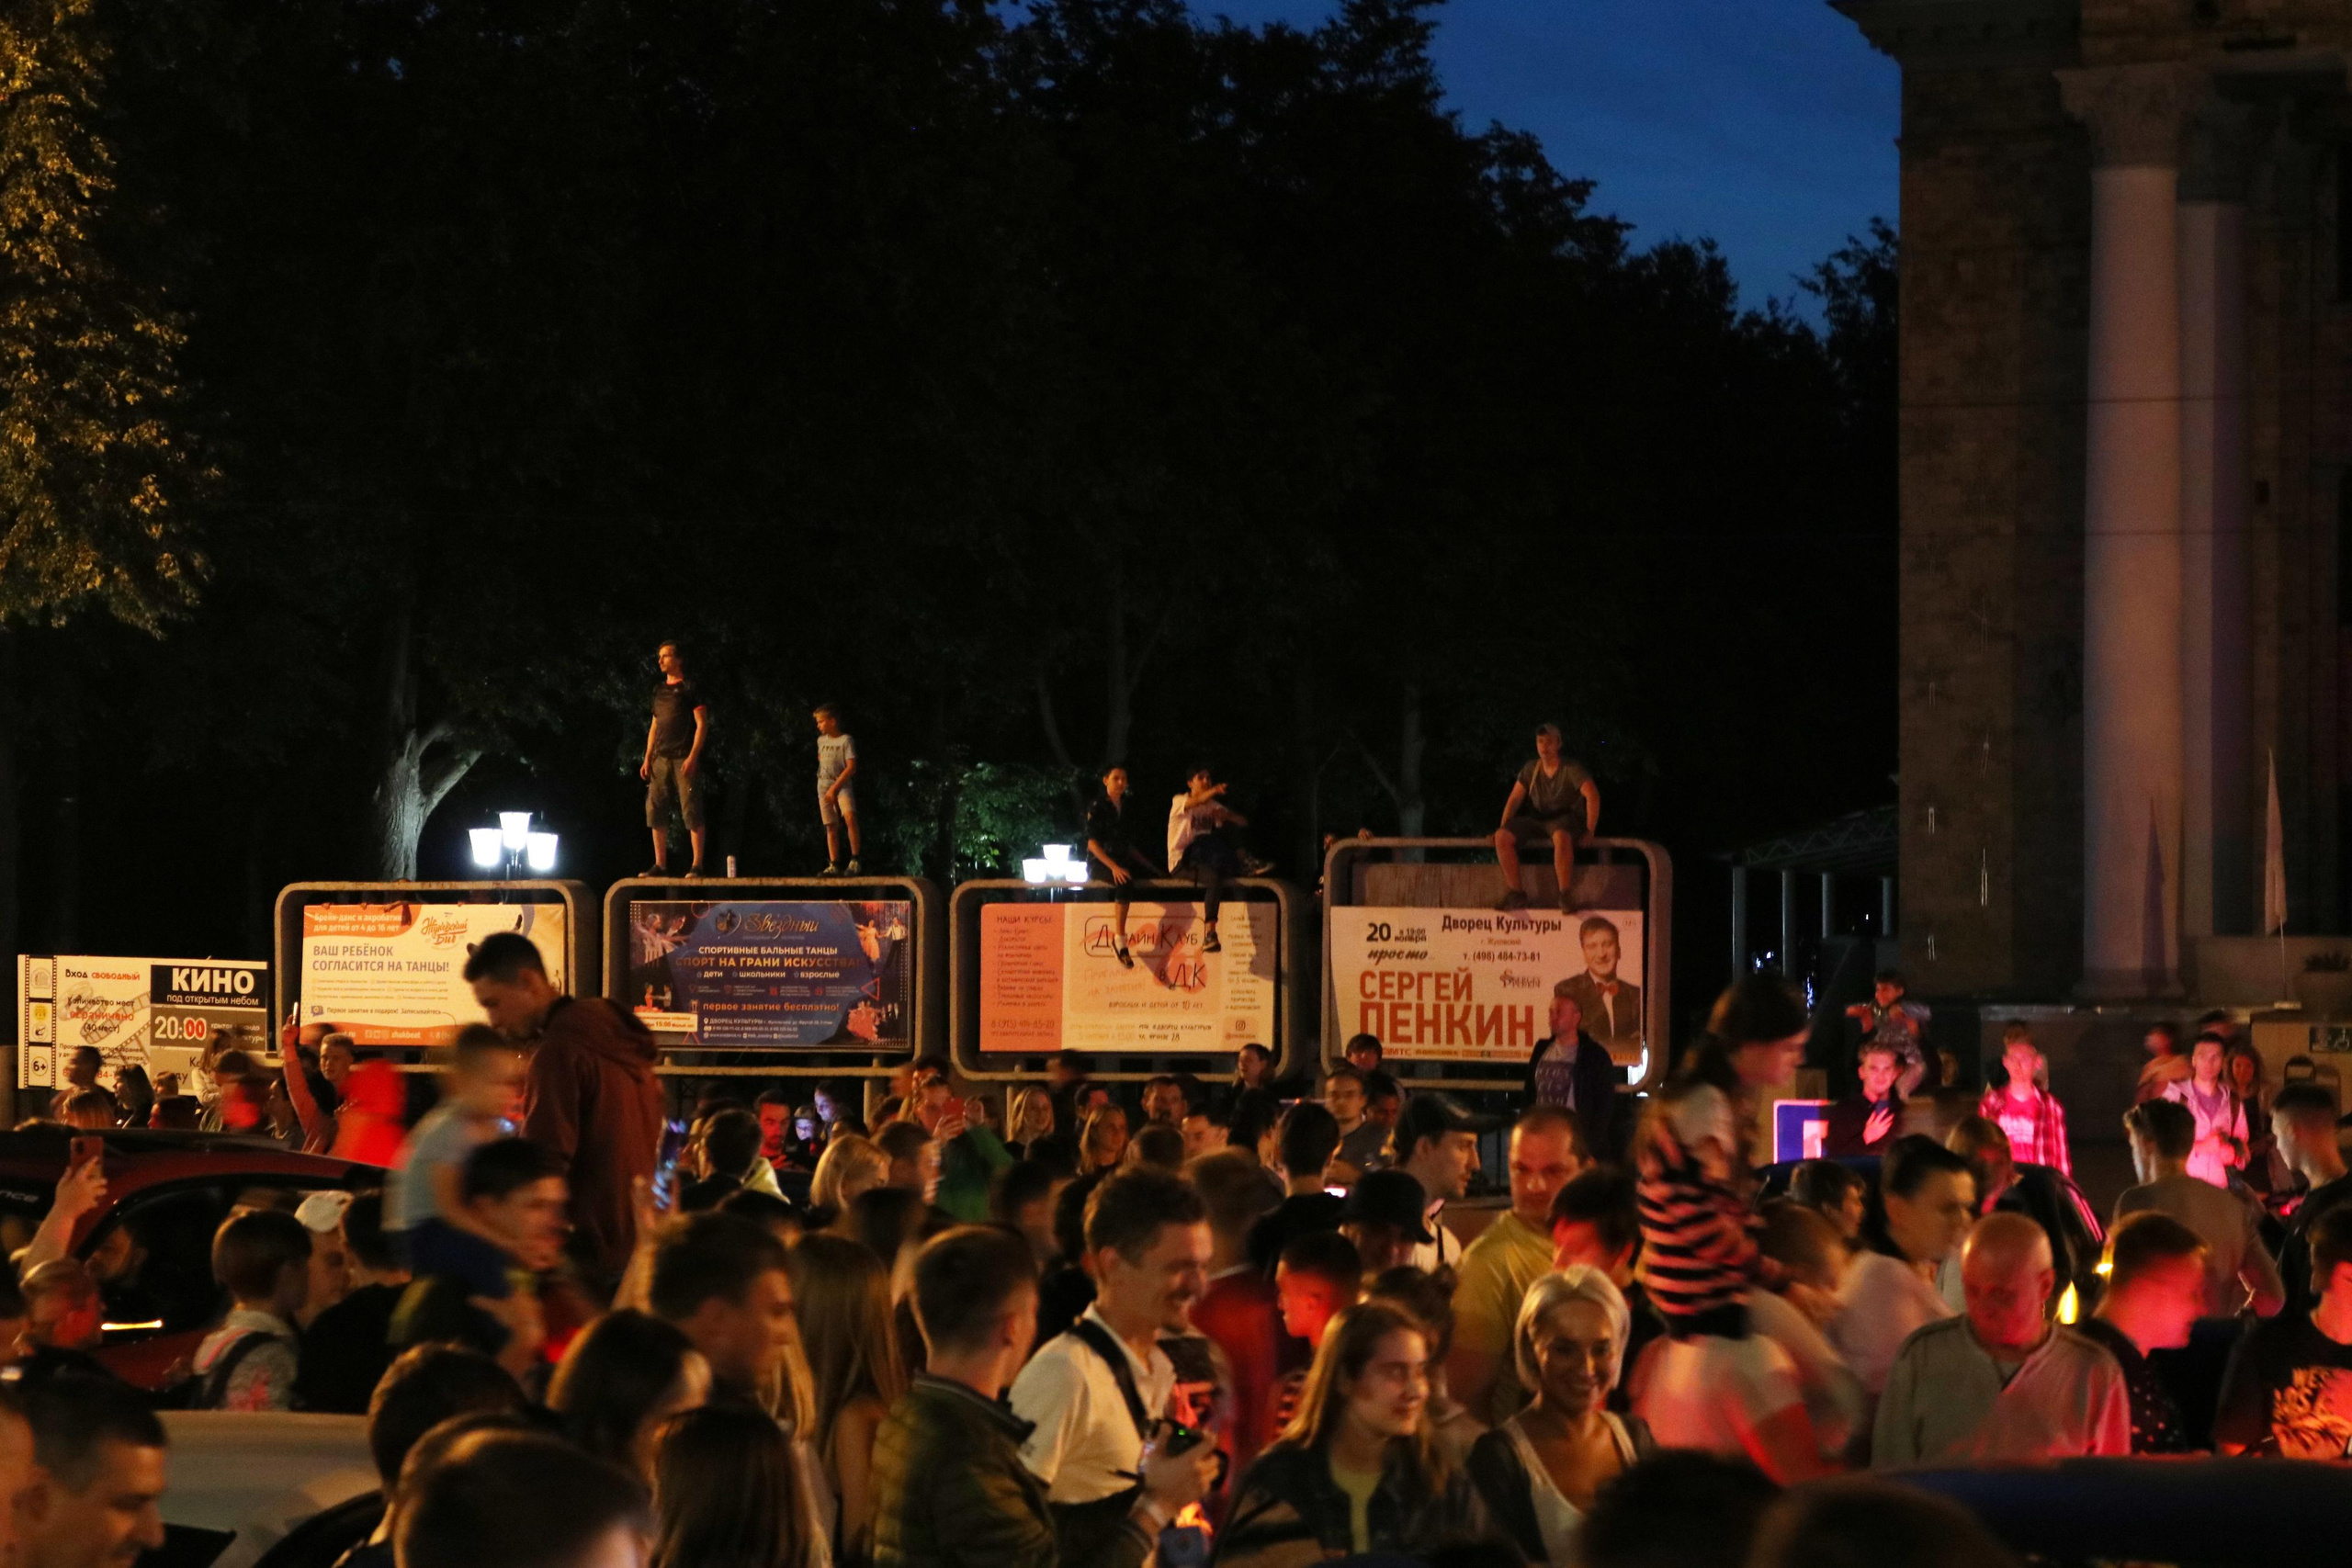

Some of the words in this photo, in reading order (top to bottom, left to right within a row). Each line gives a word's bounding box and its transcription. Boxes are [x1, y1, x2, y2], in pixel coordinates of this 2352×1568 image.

[313, 924, 328, 932] для
[329, 923, 350, 932] детей
[367, 925, 376, 933] до
[1442, 915, 1493, 932] Дворец
[1497, 917, 1562, 934] Культуры
[1366, 922, 1392, 942] 20
[313, 945, 338, 956] ВАШ
[342, 943, 393, 957] РЕБЁНОК
[698, 946, 759, 955] СПОРТИВНЫЕ
[761, 947, 804, 955] БАЛЬНЫЕ
[806, 947, 838, 956] ТАНЦЫ
[312, 960, 384, 972] СОГЛАСИТСЯ
[388, 961, 402, 972] НА
[405, 961, 449, 974] ТАНЦЫ!
[675, 958, 715, 967] СПОРТ
[718, 957, 736, 967] НА
[740, 957, 780, 967] ГРАНИ
[65, 968, 88, 979] Вход
[91, 971, 141, 981] свободный
[172, 967, 255, 995] КИНО
[703, 971, 723, 979] дети
[799, 971, 840, 979] взрослые
[1169, 963, 1205, 991] ДК
[1360, 966, 1473, 1001] СЕРГЕЙ
[166, 994, 184, 1004] под
[185, 995, 229, 1006] открытым
[231, 996, 259, 1006] небом
[703, 1003, 738, 1011] первое
[741, 1003, 781, 1011] занятие
[784, 1002, 840, 1011] бесплатно!
[327, 1007, 346, 1015] Первое
[154, 1015, 208, 1041] 20:00
[1359, 1001, 1534, 1048] ПЕНКИН
[33, 1060, 46, 1072] 6+
